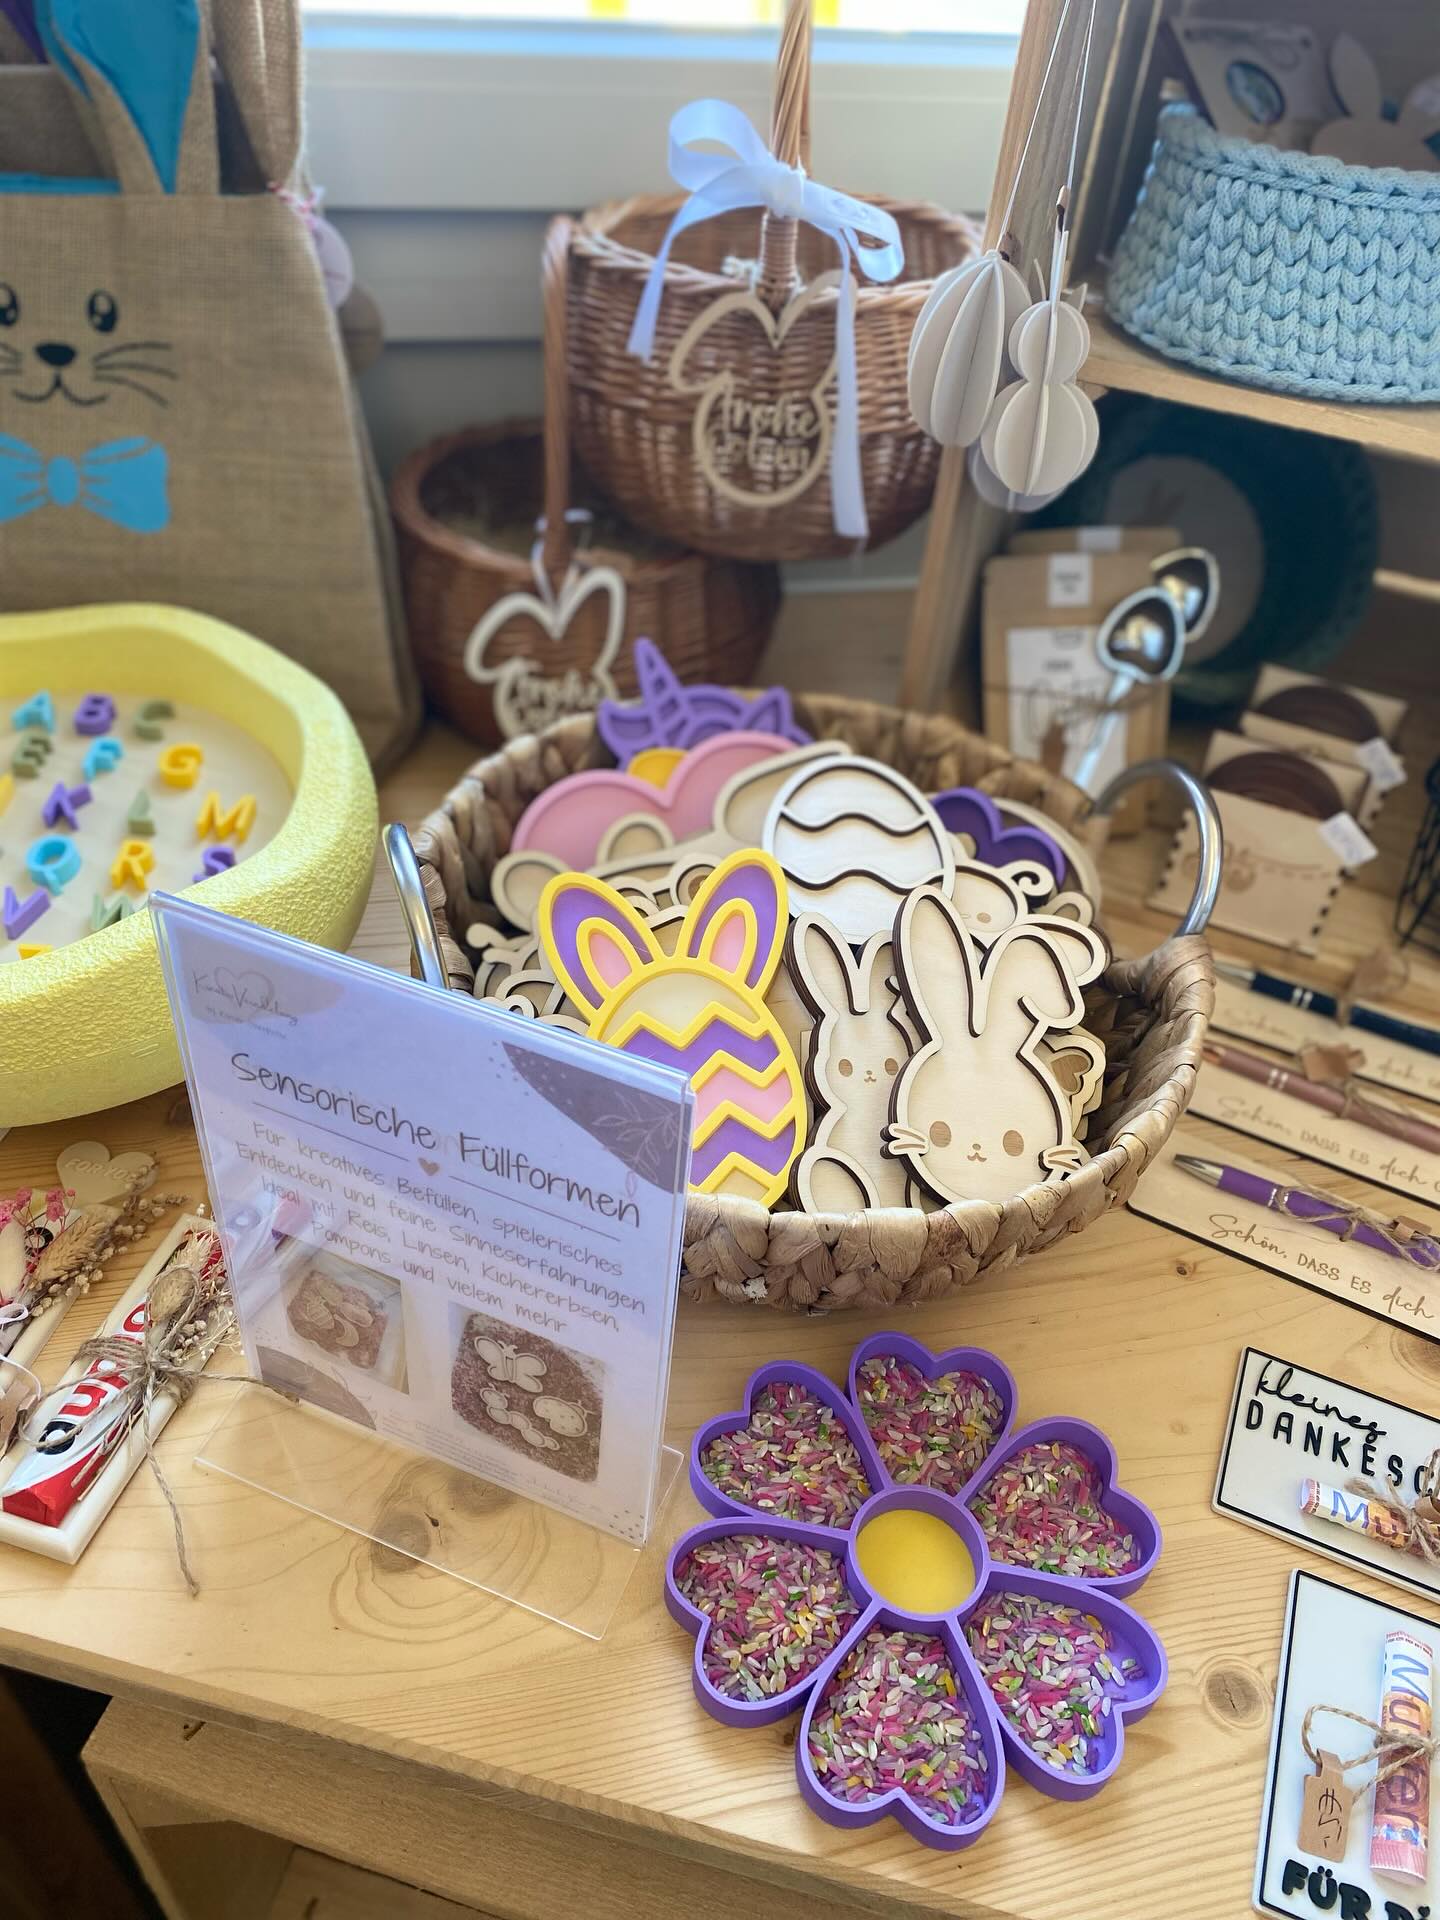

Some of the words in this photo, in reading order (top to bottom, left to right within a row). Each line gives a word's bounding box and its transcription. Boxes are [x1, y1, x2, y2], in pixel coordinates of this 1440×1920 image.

[74, 693, 117, 736] B
[158, 743, 204, 789] G
[42, 781, 93, 831] K
[195, 791, 257, 845] M
[26, 834, 82, 896] Q
[110, 839, 156, 891] R
[192, 845, 236, 884] S
[3, 885, 50, 941] V
[231, 1052, 436, 1149] Sensorische
[460, 1132, 640, 1228] Füllformen
[1379, 1157, 1426, 1185] dich
[235, 1141, 333, 1193] Entdecken
[343, 1186, 376, 1209] und
[387, 1200, 437, 1232] feine
[449, 1225, 646, 1315] Sinneserfahrungen
[252, 1121, 286, 1147] Für
[297, 1138, 385, 1186] kreatives
[397, 1176, 479, 1225] Befüllen,
[492, 1217, 623, 1277] spielerisches
[261, 1175, 300, 1206] Ideal
[312, 1199, 337, 1218] mit
[347, 1209, 391, 1243] Reis,
[402, 1231, 470, 1273] Linsen,
[482, 1262, 620, 1332] Kichererbsen,
[311, 1220, 391, 1265] Pompons
[402, 1260, 434, 1284] und
[447, 1278, 504, 1310] vielem
[515, 1302, 568, 1333] mehr
[1297, 1252, 1341, 1282] DASS
[1350, 1275, 1372, 1295] ES
[1382, 1285, 1435, 1320] dich
[1255, 1360, 1388, 1444] kleines
[1282, 1858, 1372, 1920] FÜR
